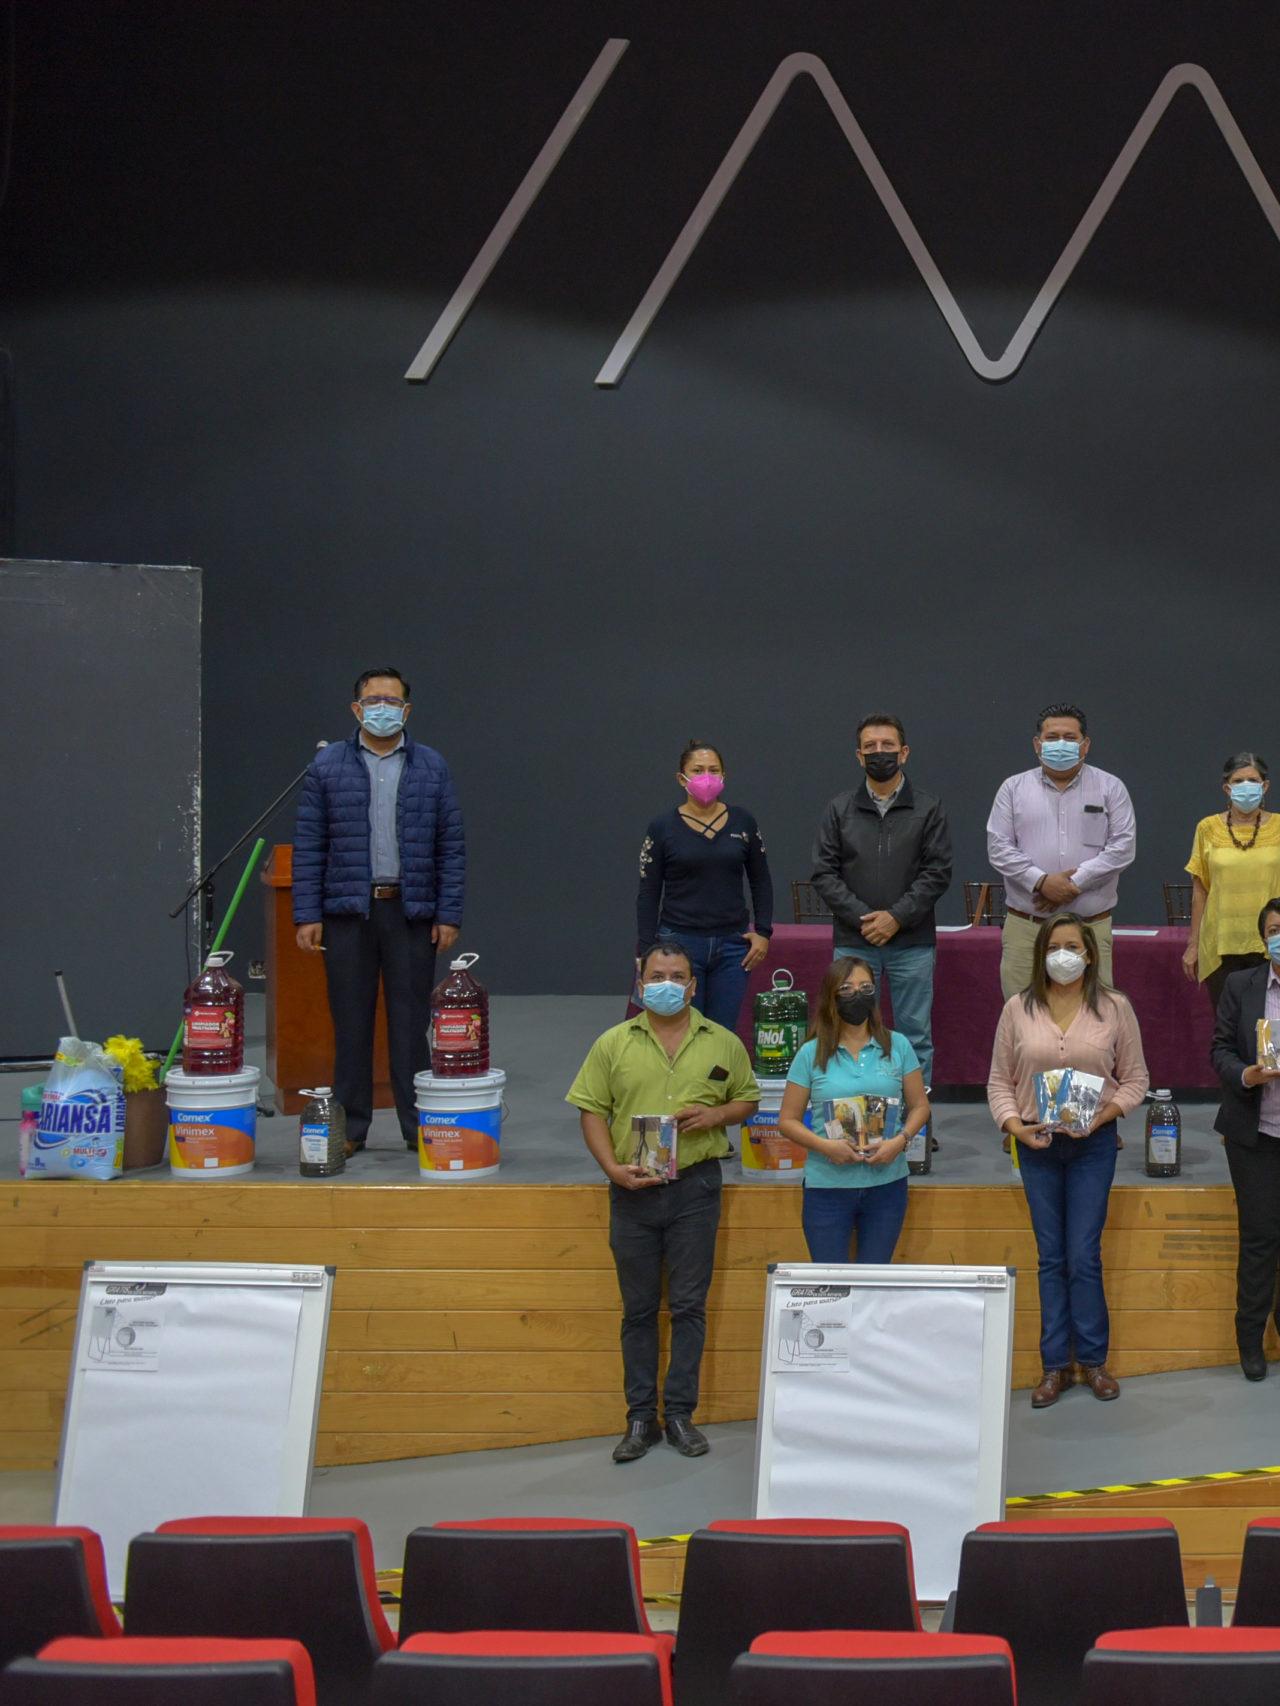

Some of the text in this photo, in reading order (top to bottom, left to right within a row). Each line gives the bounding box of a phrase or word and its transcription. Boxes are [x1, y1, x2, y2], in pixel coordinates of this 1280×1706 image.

[40, 1103, 112, 1134] ARIANSA
[177, 1112, 214, 1123] Comex
[424, 1114, 460, 1124] Comex
[753, 1114, 780, 1125] Come
[175, 1126, 215, 1136] Vinimex
[423, 1127, 461, 1138] Vinimex
